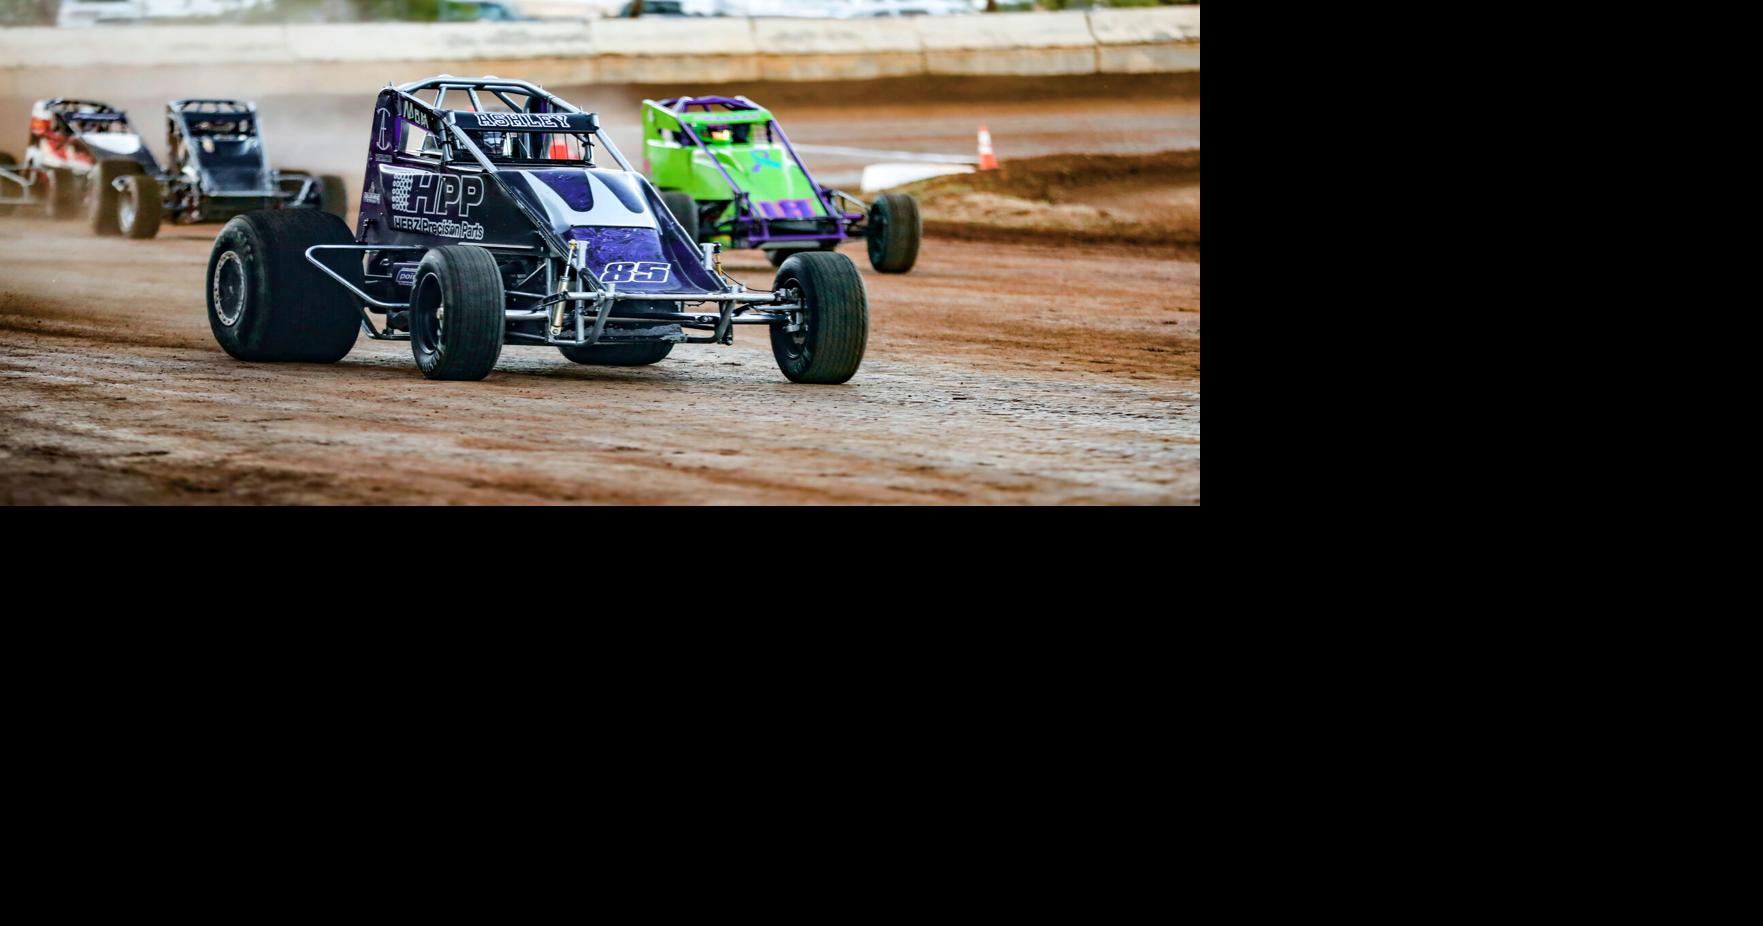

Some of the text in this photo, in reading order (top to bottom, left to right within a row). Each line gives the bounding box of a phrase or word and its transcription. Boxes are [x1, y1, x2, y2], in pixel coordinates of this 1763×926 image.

[474, 113, 571, 128] ASHLEY
[392, 173, 484, 217] HPP
[393, 215, 485, 240] HERZ Precision Parts
[599, 261, 672, 283] 85
